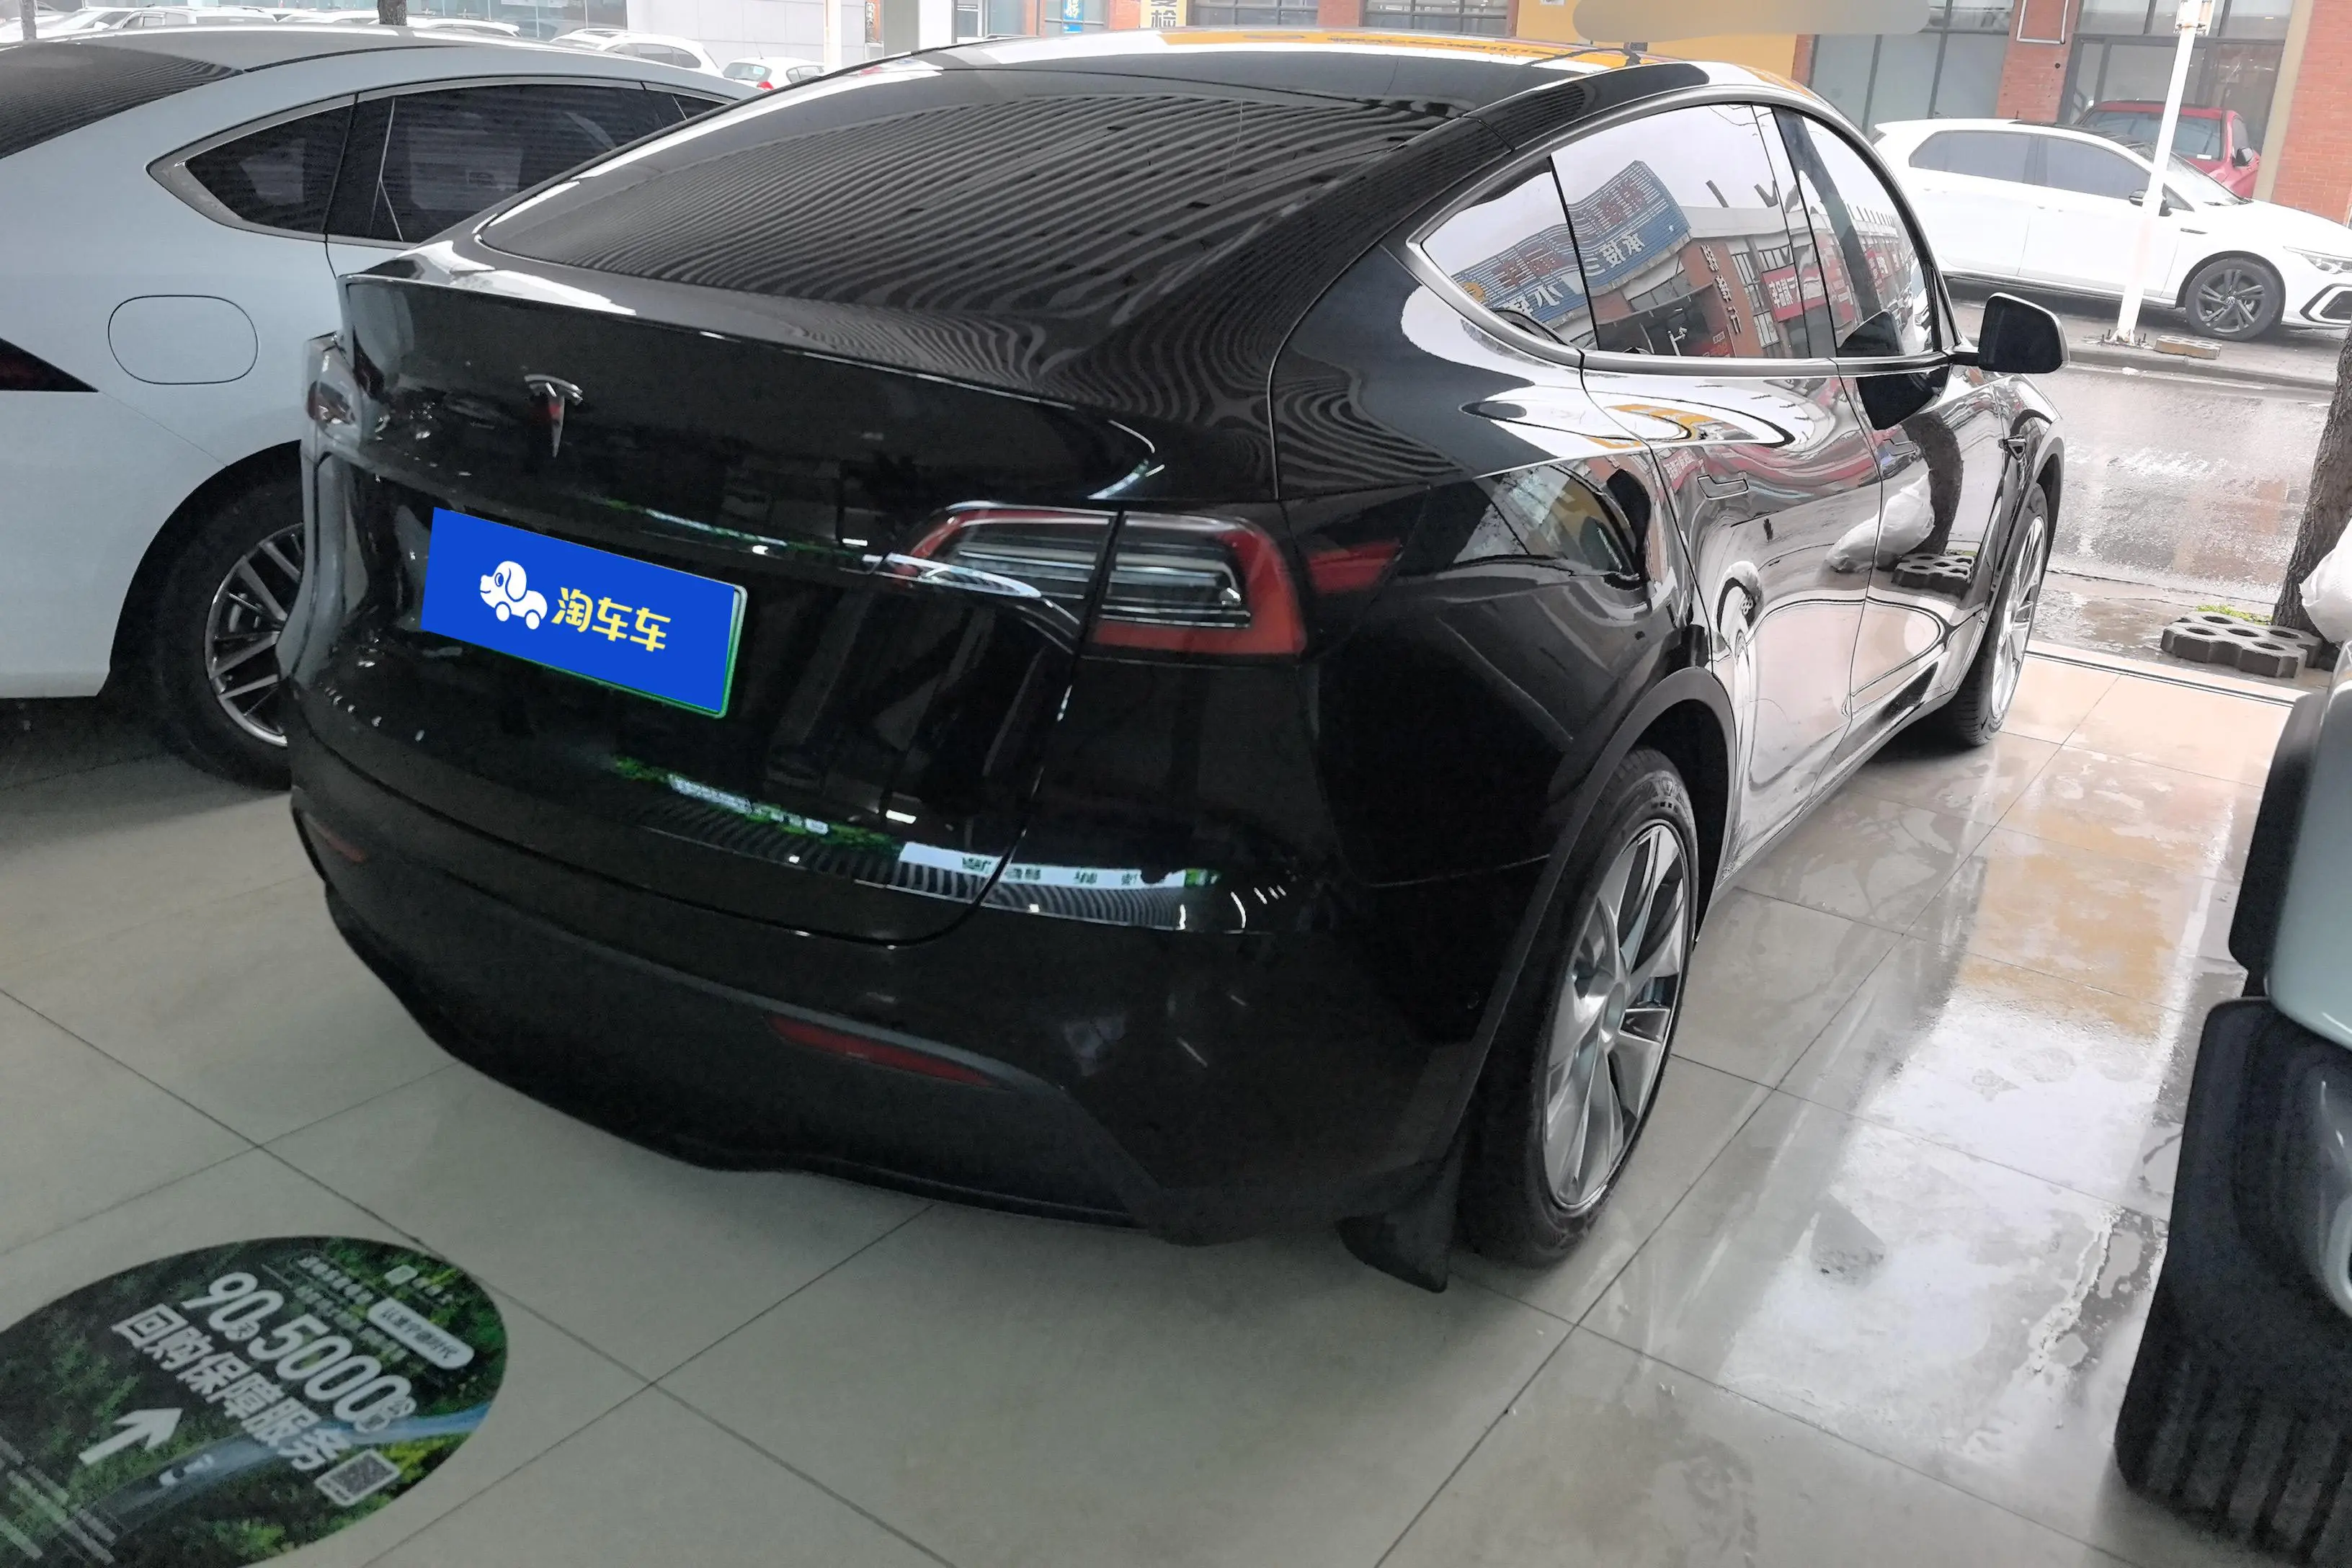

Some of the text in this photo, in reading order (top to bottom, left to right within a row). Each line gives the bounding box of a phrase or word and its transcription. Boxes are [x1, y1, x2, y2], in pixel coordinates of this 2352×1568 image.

[112, 1304, 352, 1471] 回购保障服务
